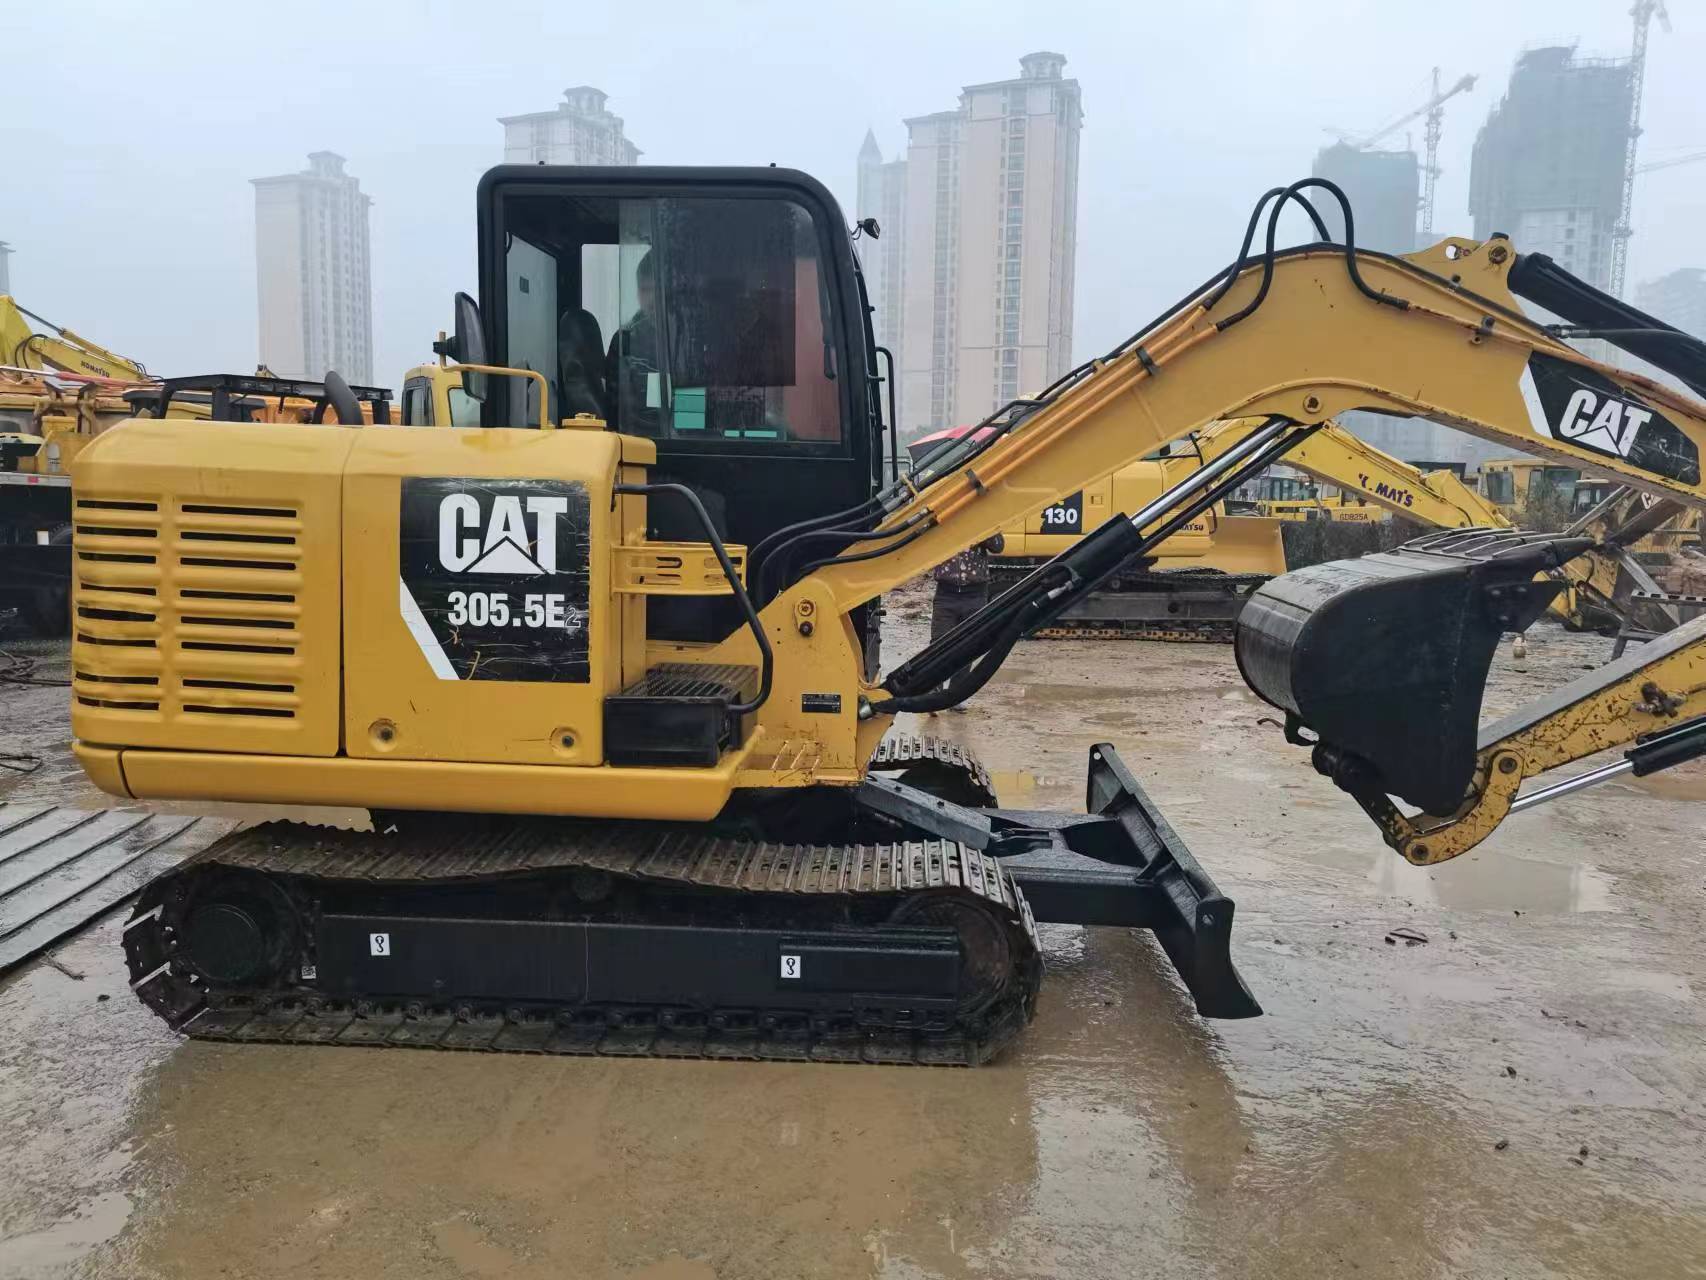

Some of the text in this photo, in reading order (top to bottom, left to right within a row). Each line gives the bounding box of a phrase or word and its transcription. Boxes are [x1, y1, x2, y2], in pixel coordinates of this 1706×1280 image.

[1559, 389, 1652, 457] CAT
[438, 493, 567, 575] CAT
[1045, 507, 1078, 524] 130
